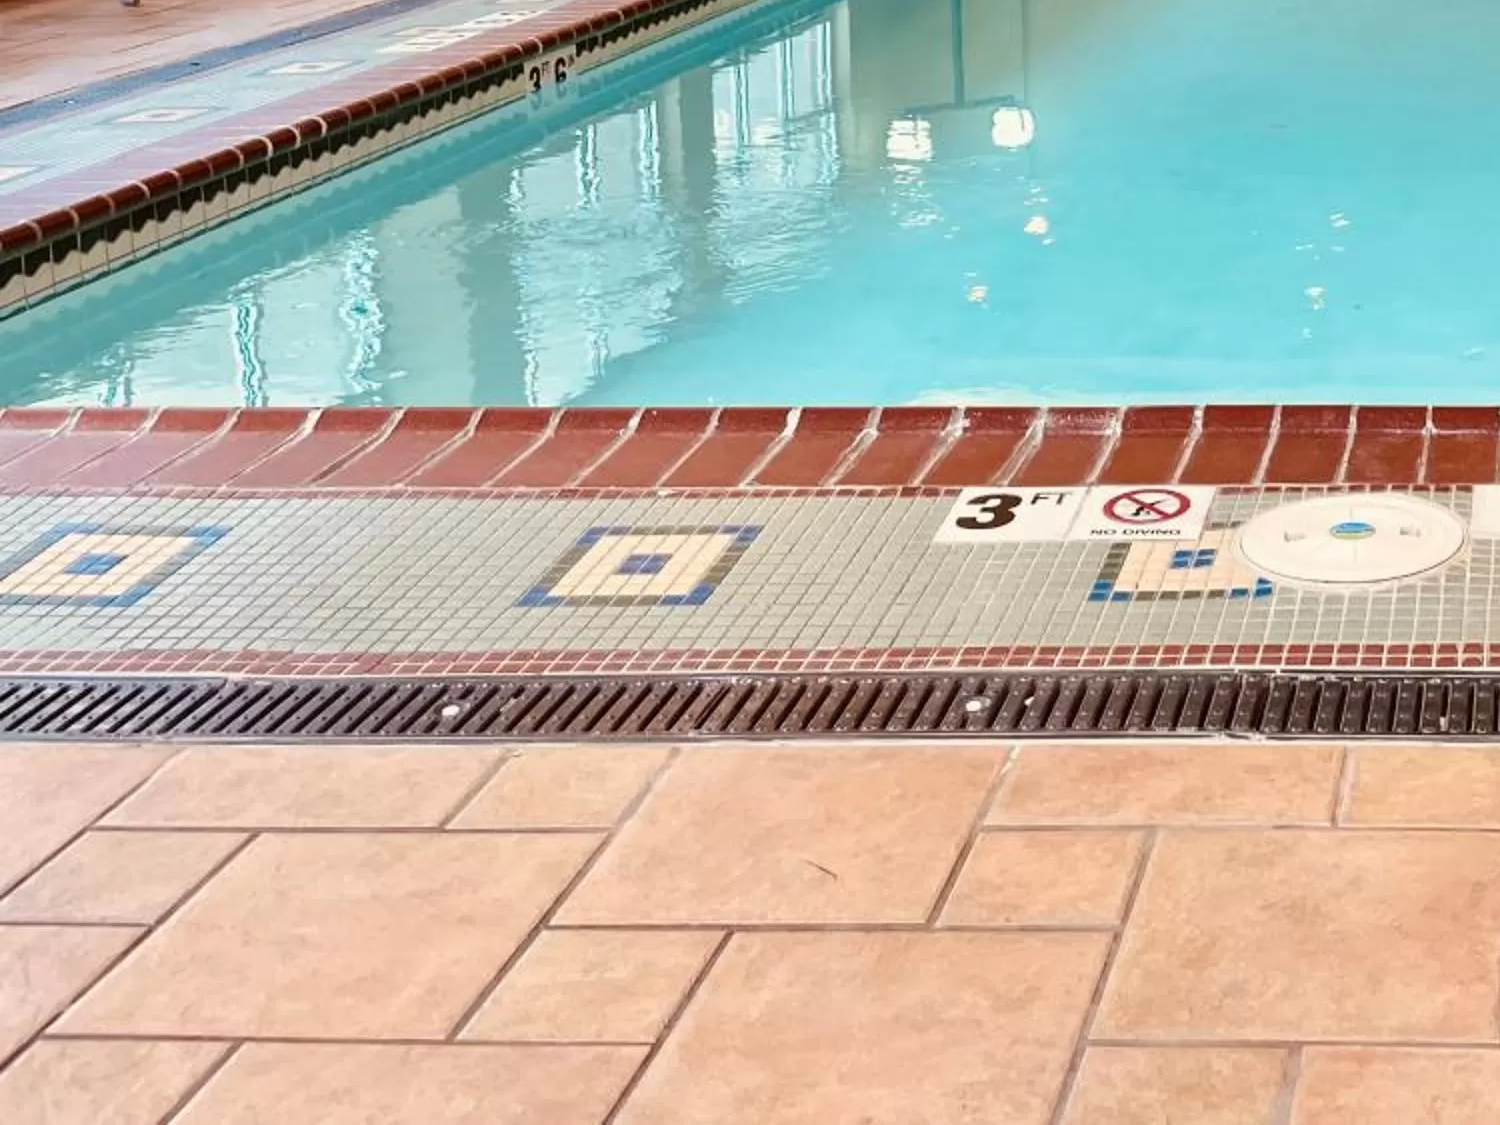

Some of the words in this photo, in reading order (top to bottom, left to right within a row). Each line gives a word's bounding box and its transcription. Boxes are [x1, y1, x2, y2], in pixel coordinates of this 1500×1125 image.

[955, 493, 1023, 530] 3
[1031, 492, 1073, 506] FT
[1090, 528, 1118, 536] NO
[1121, 528, 1182, 536] DIVING
